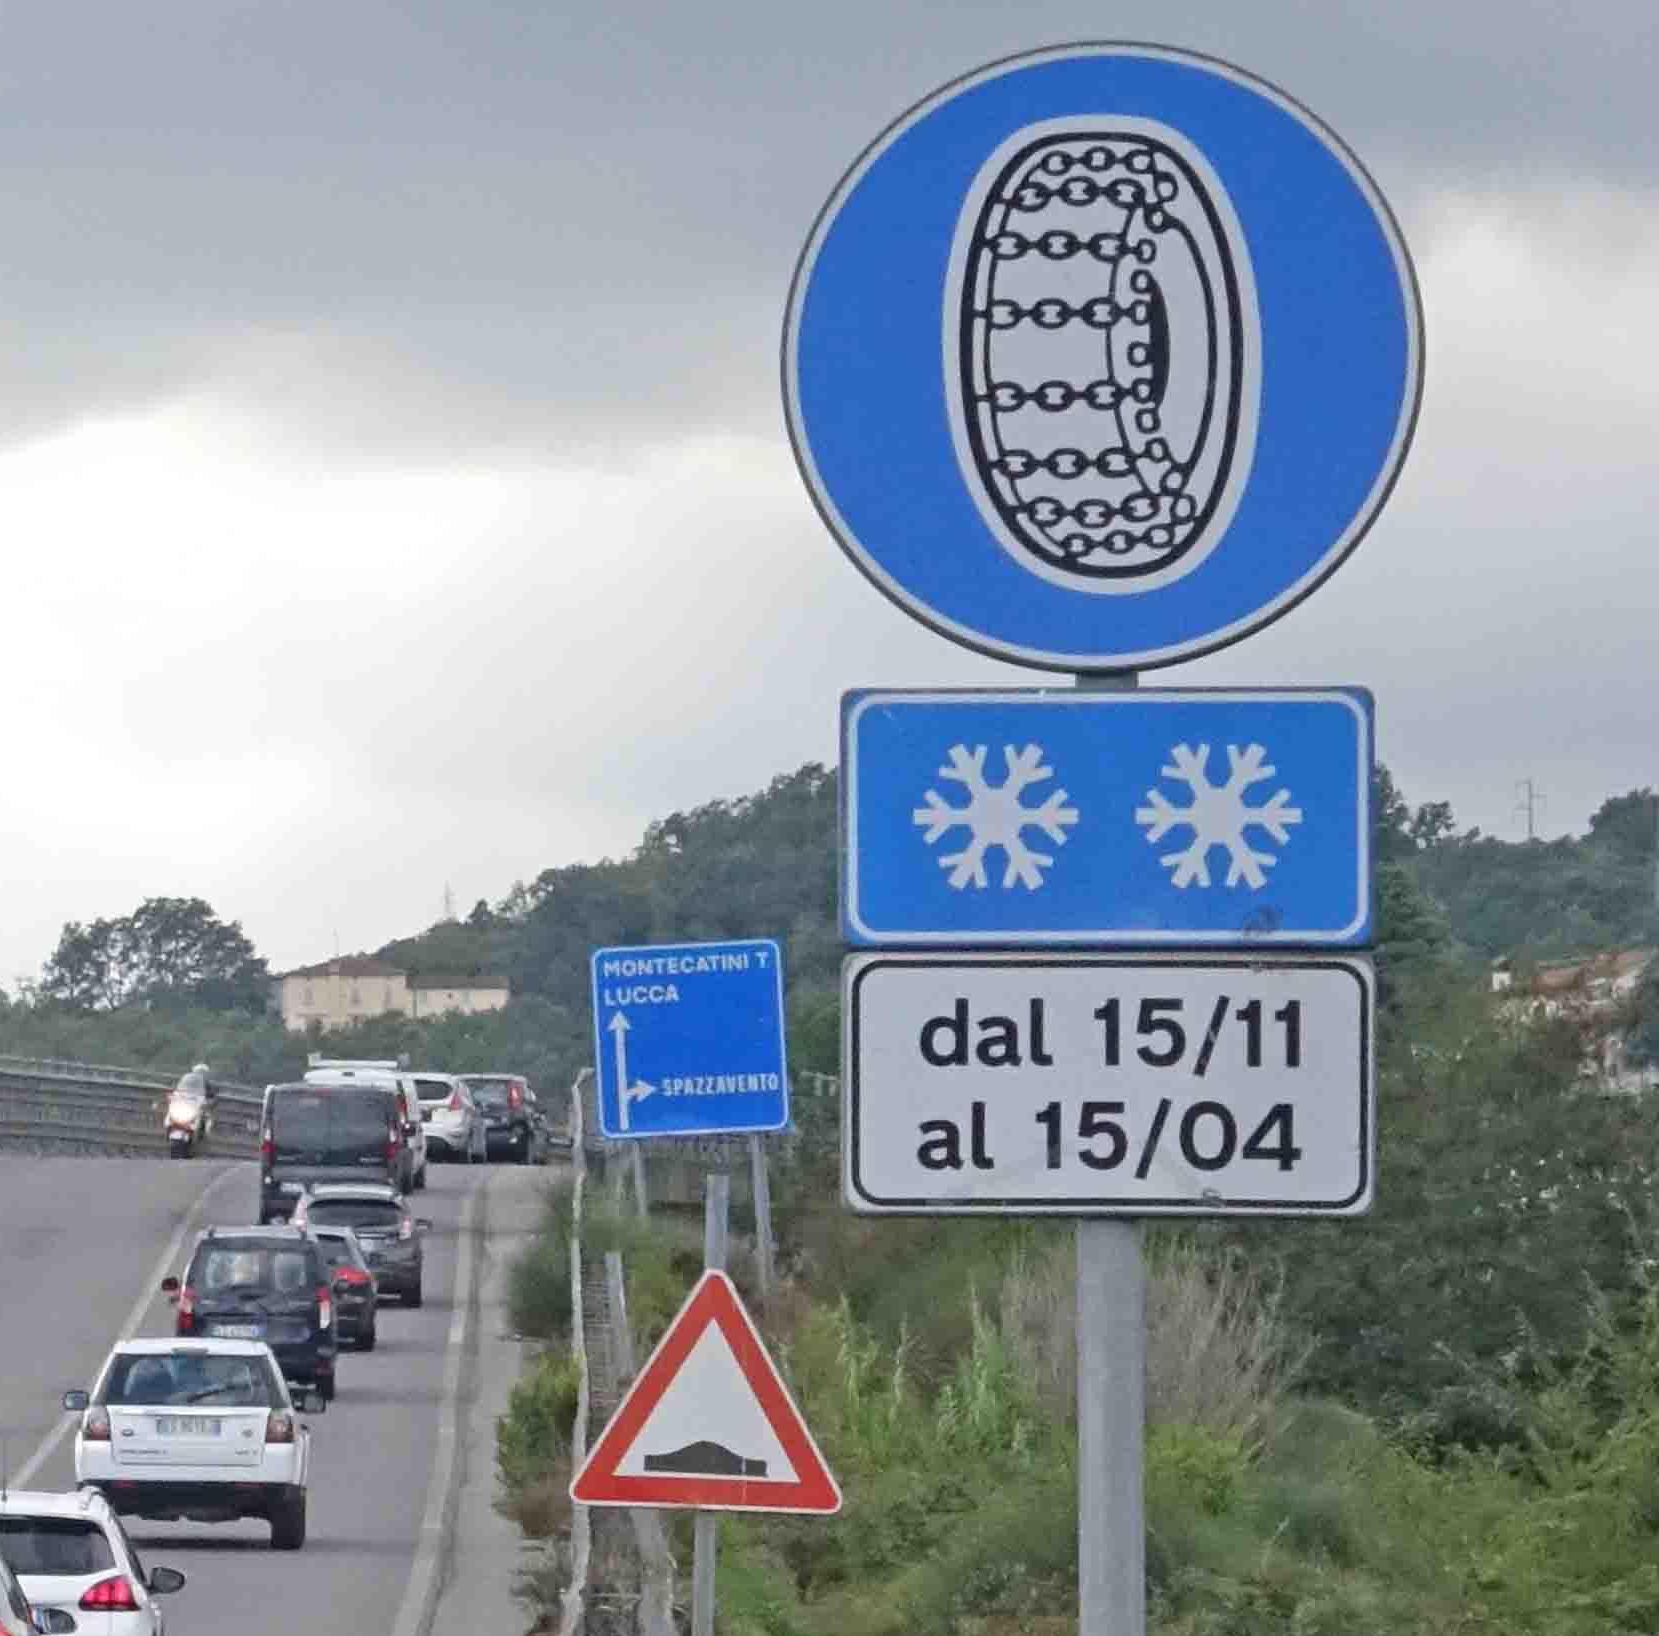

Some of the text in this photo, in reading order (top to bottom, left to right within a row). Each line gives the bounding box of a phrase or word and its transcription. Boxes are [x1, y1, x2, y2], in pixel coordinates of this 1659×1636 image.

[603, 954, 749, 977] MONTECATINI
[604, 984, 679, 1006] LUCCA
[919, 996, 1301, 1077] dal 15/11
[661, 1073, 779, 1097] SPAZZAVENTO
[916, 1098, 1301, 1180] al 15/04
